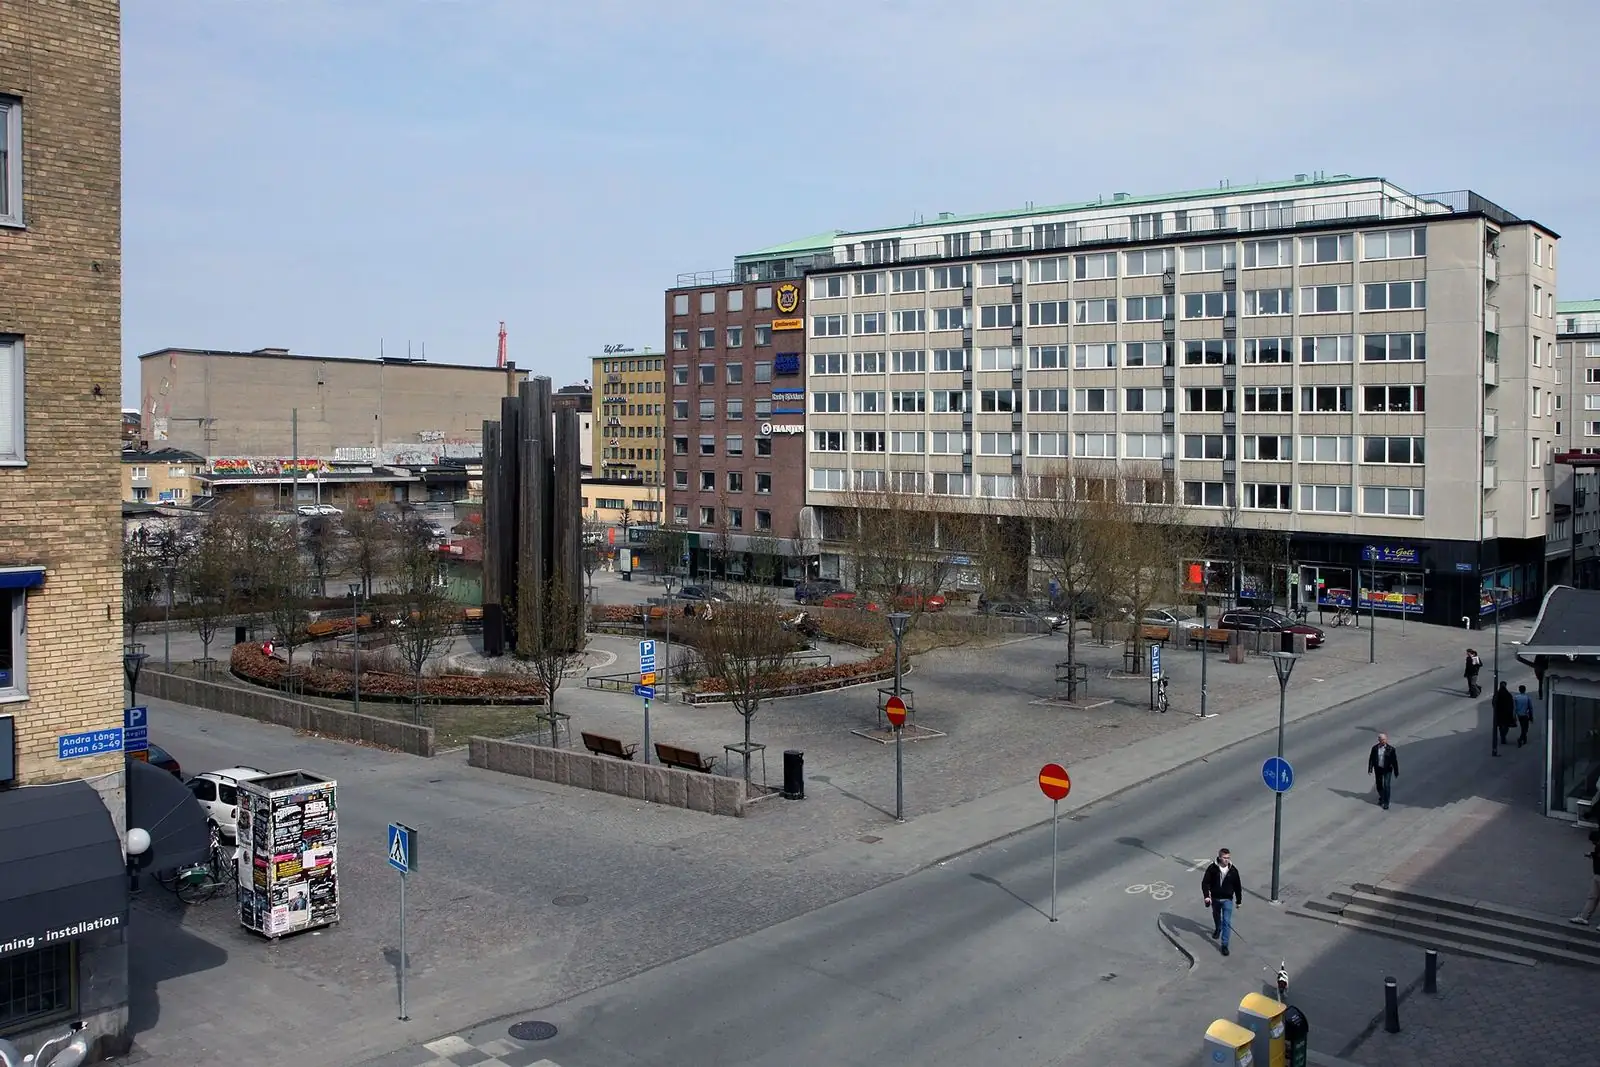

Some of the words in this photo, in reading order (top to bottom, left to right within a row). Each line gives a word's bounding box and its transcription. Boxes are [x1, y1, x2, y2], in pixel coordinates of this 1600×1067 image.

[773, 424, 805, 435] HANJIN
[644, 642, 652, 655] P
[129, 709, 142, 727] P
[62, 737, 91, 747] Andra
[93, 732, 120, 743] Lång-
[62, 747, 89, 757] gatan
[91, 740, 121, 751] 63-49
[46, 916, 119, 941] installation
